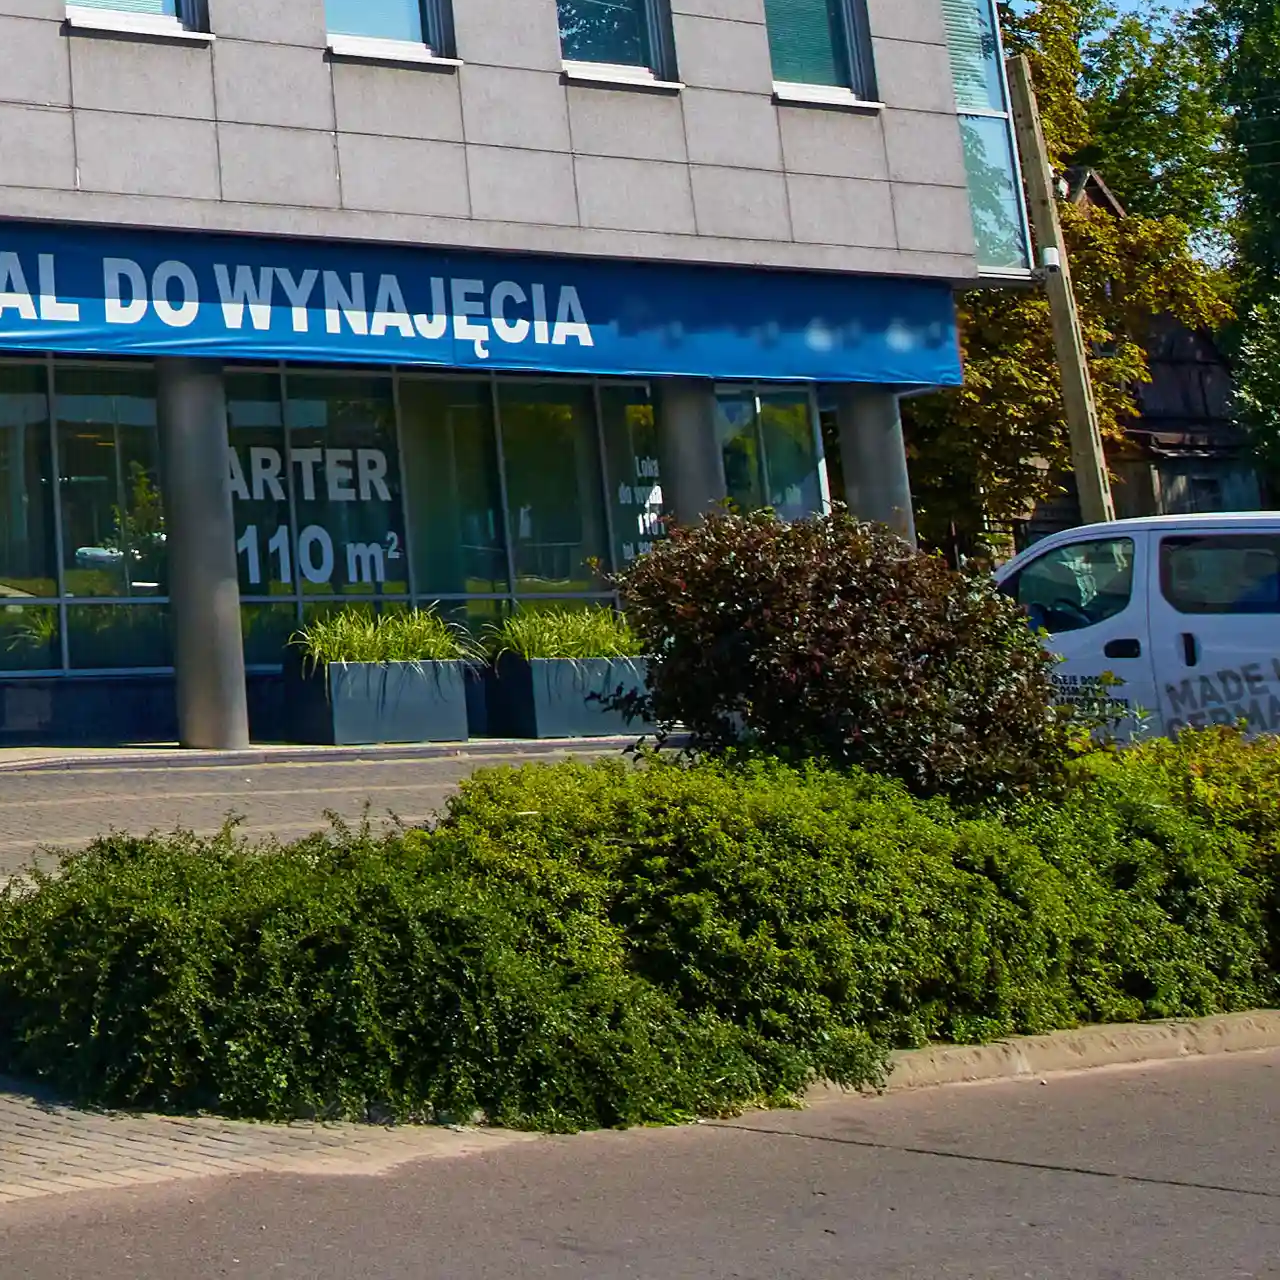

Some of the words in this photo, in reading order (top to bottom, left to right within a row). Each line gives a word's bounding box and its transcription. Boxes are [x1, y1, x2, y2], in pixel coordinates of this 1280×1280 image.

[103, 257, 199, 328] DO
[213, 263, 595, 359] WYNAJĘCIA
[227, 446, 392, 501] ARTER
[237, 524, 334, 584] 110
[1165, 663, 1269, 713] MADE
